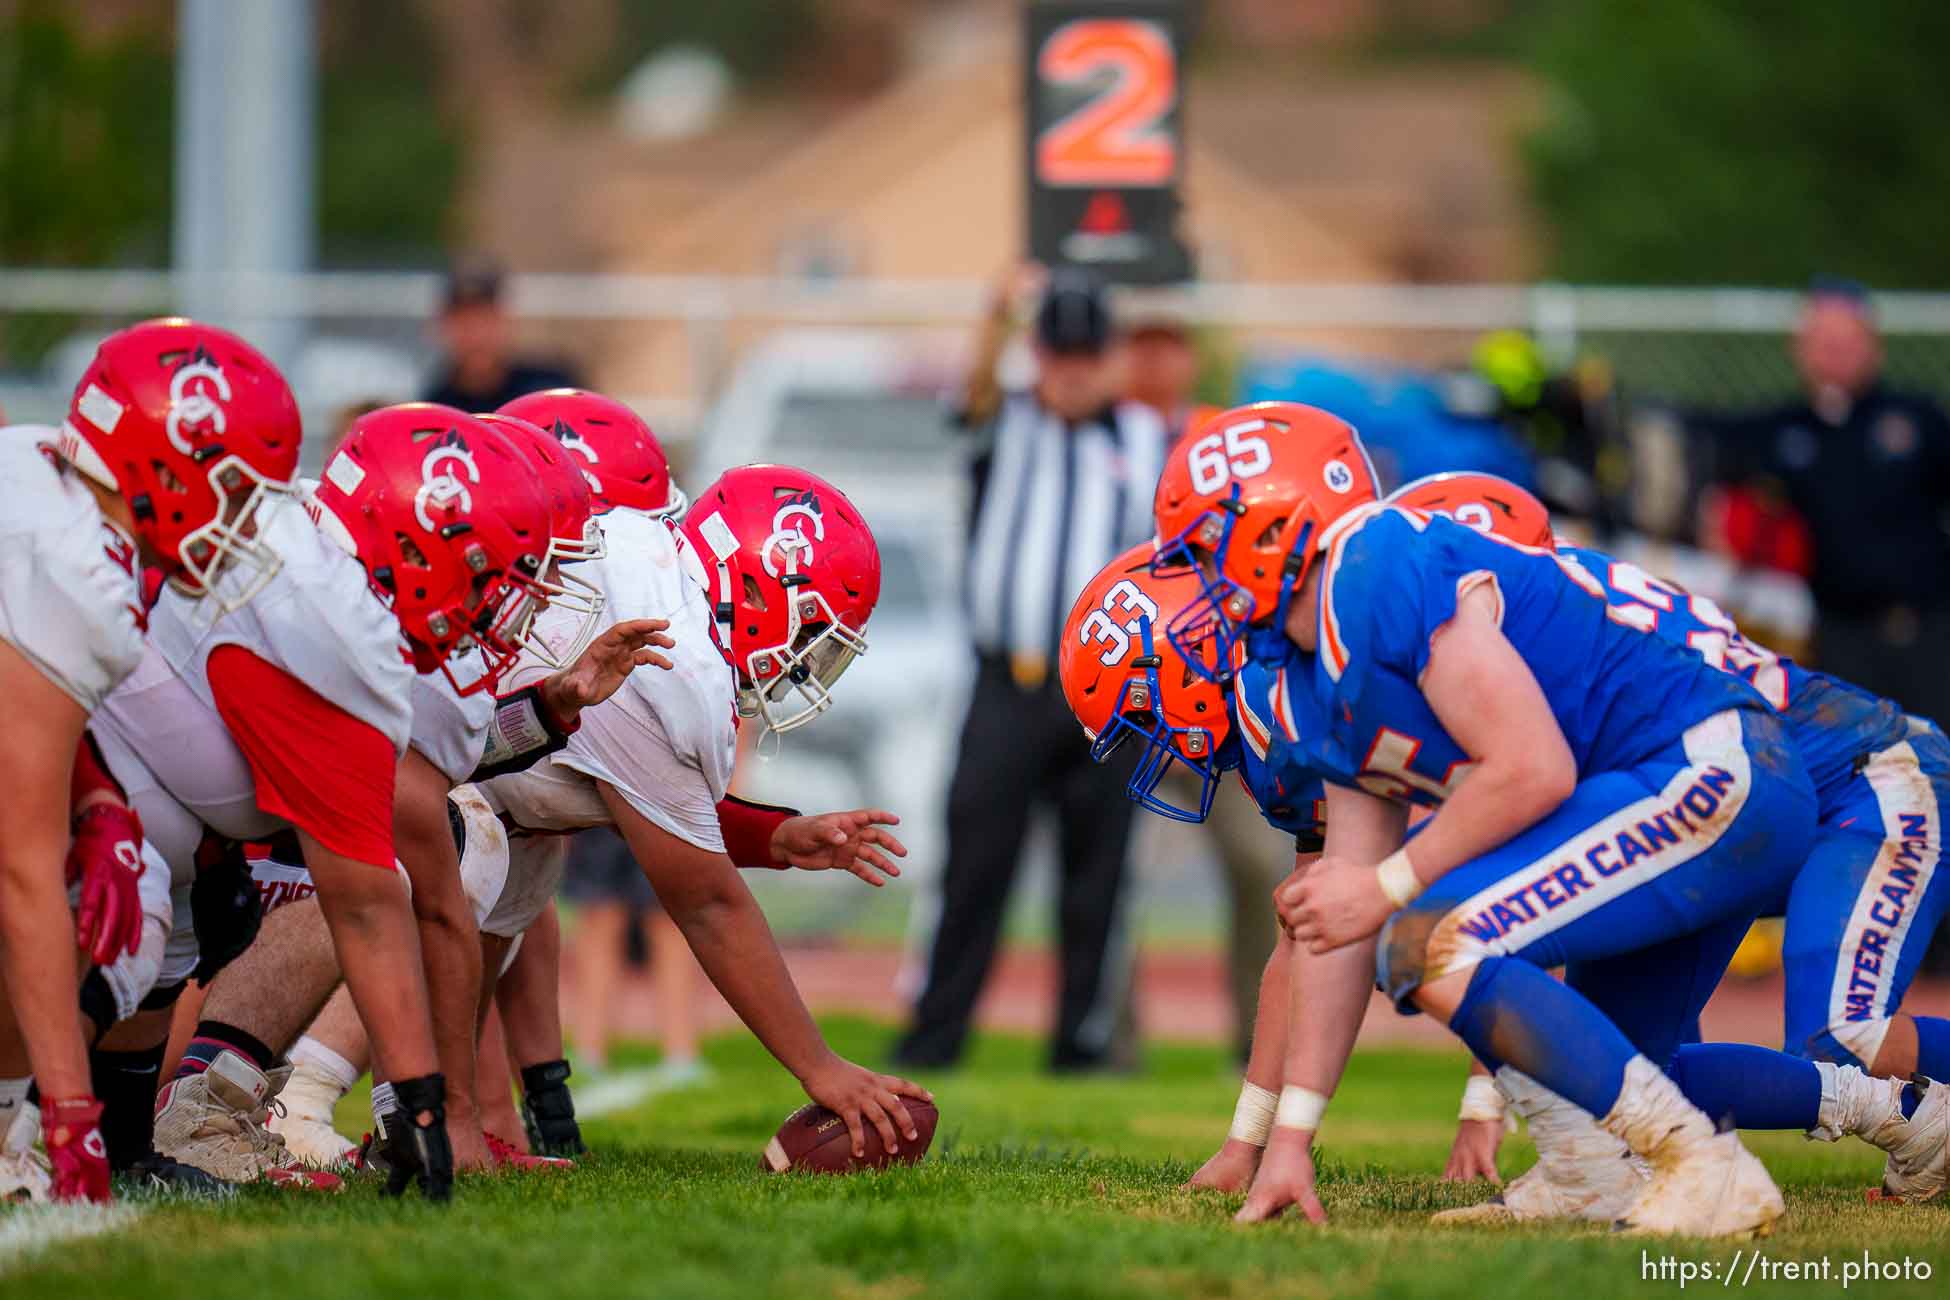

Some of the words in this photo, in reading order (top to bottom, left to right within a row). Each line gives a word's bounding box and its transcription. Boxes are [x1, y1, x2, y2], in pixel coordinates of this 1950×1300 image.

[1037, 17, 1178, 187] 2
[1187, 419, 1272, 496] 65
[1329, 466, 1349, 487] 65
[1080, 579, 1158, 667] 33
[1456, 860, 1595, 944] WATER
[1585, 764, 1735, 879] CANYON
